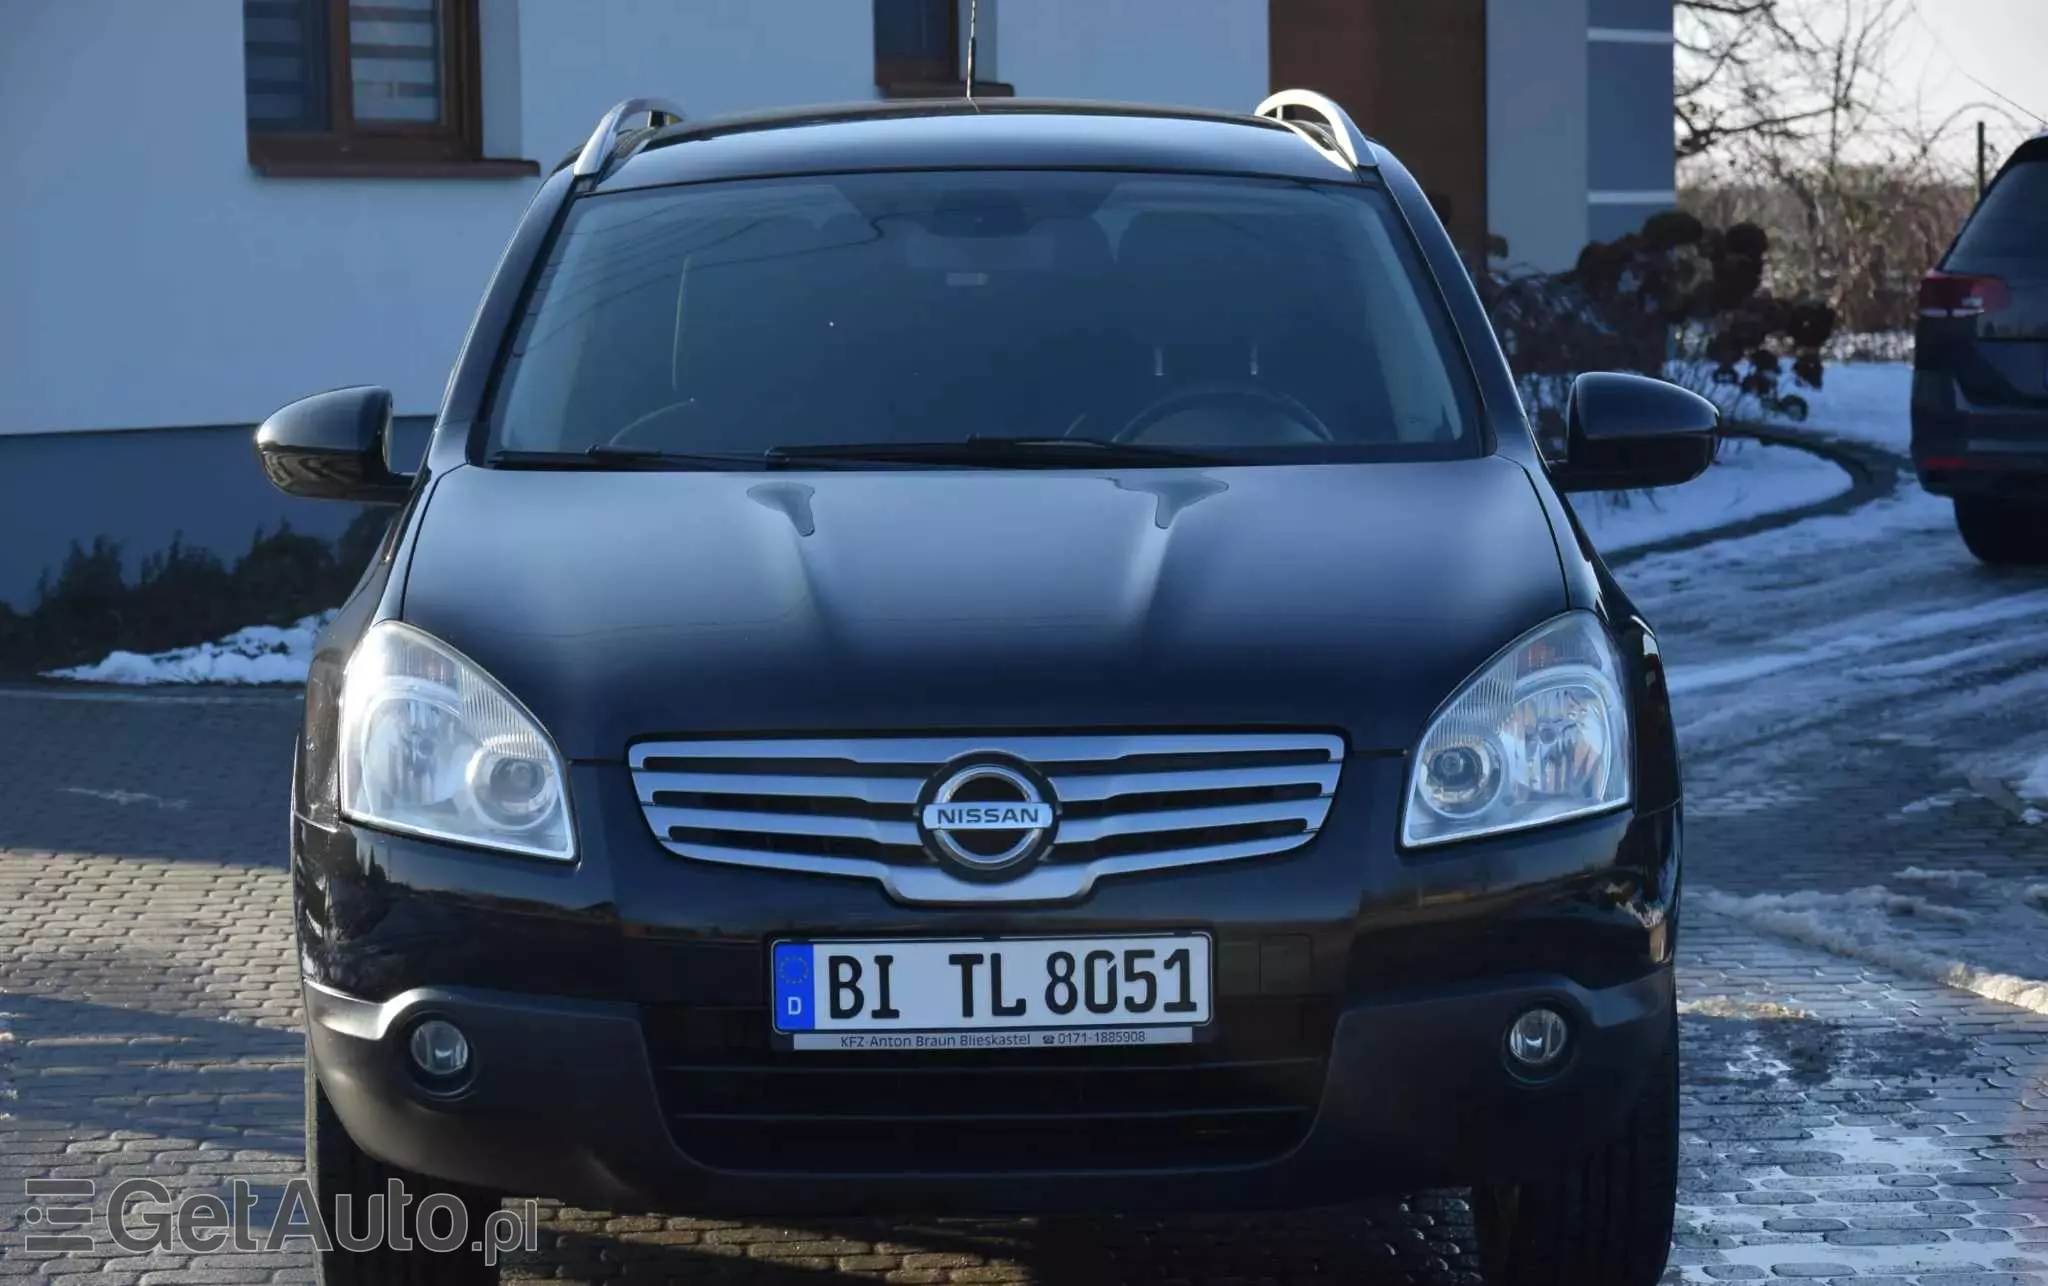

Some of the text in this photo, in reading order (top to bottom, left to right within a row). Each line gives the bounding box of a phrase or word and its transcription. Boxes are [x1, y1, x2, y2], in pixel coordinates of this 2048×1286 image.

[937, 808, 1039, 824] NISSAN
[828, 948, 1198, 1020] BI TL 8051
[787, 996, 802, 1015] D
[915, 1034, 956, 1047] Braun
[959, 1033, 1031, 1047] Blieskastel
[1057, 1030, 1146, 1045] 0171-1885908
